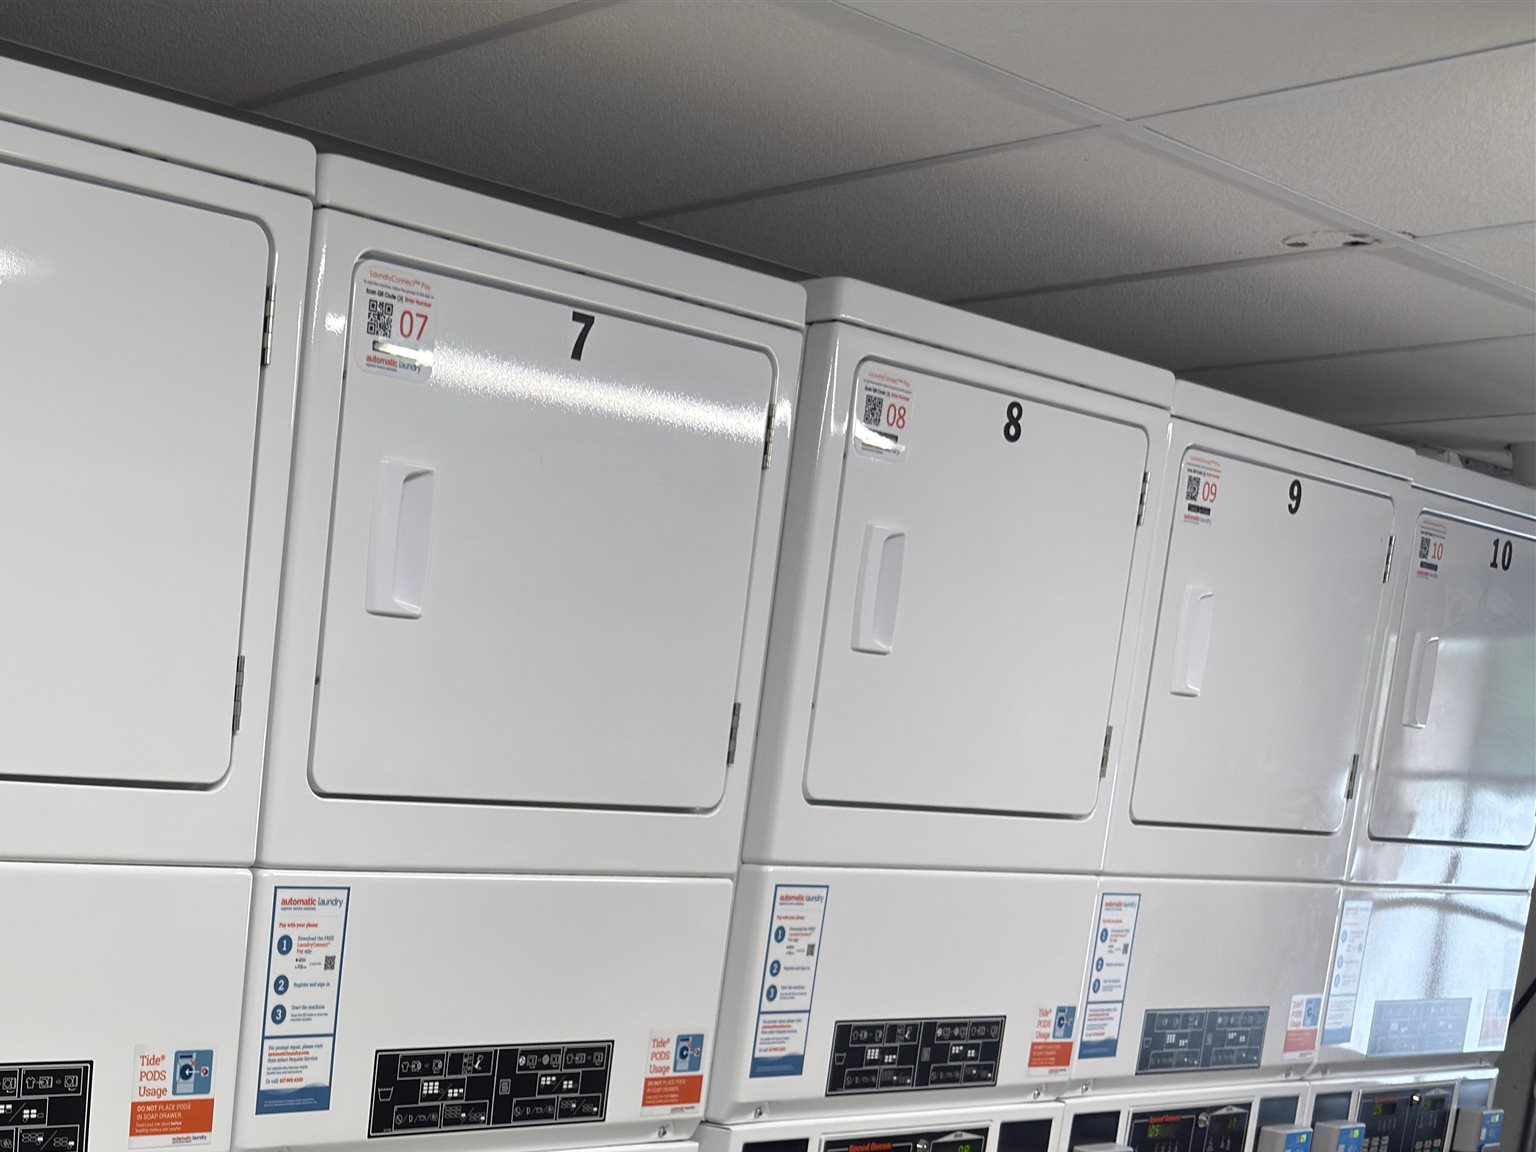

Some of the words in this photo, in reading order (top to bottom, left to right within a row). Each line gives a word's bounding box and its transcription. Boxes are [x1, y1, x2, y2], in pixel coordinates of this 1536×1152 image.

[385, 292, 396, 300] Code
[400, 310, 428, 341] 07
[571, 310, 595, 361] 7
[887, 403, 906, 429] 08
[1004, 401, 1023, 443] 8
[1202, 481, 1217, 503] 09
[1288, 480, 1302, 514] 9
[1432, 542, 1443, 560] 10
[1490, 538, 1512, 571] 10
[281, 897, 316, 906] automatic
[318, 897, 343, 908] laundry
[805, 894, 824, 904] laundry
[282, 940, 287, 951] 1
[278, 980, 284, 991] 2
[276, 1009, 282, 1020] 3
[651, 1051, 670, 1061] PODS
[650, 1065, 670, 1075] Usage
[140, 1071, 166, 1081] PODS
[139, 1087, 167, 1099] Usage
